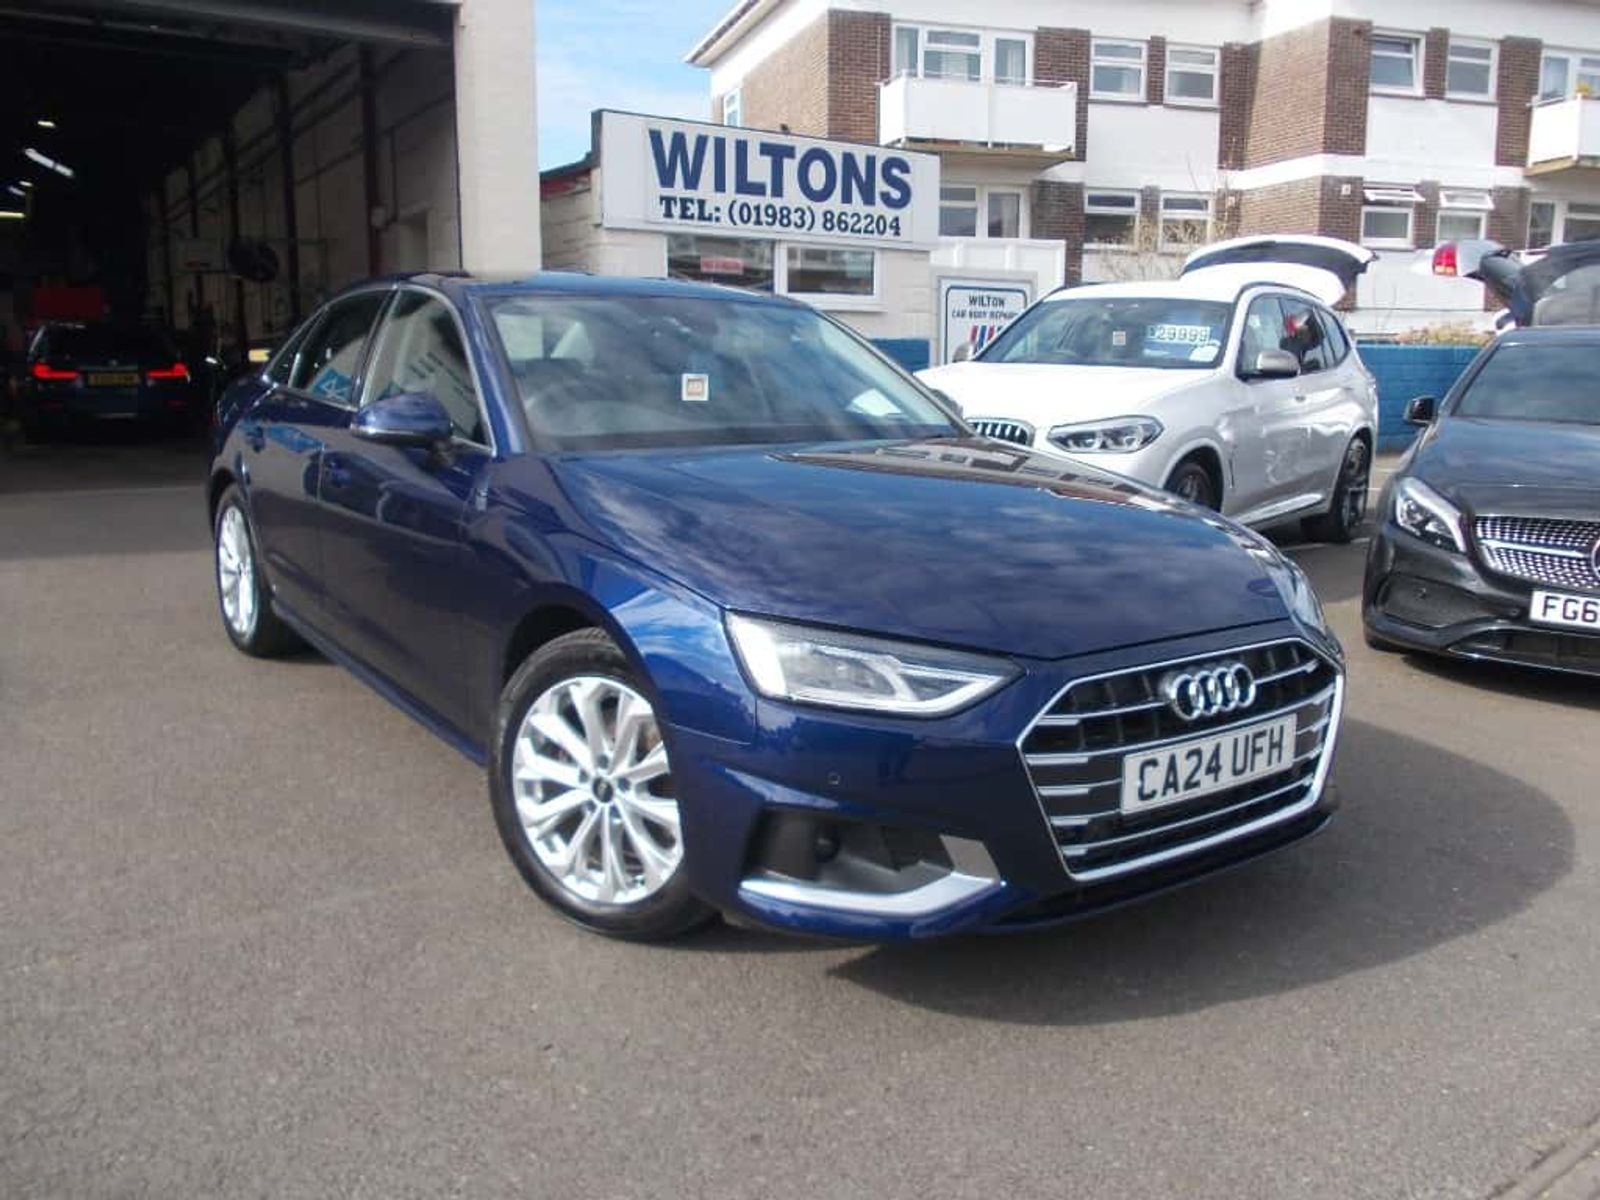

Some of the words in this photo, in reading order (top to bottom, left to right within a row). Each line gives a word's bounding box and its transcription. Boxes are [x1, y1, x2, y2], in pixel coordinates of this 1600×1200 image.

[648, 129, 912, 209] WILTONS
[659, 195, 721, 222] TEL:
[728, 199, 816, 231] (01983)
[822, 210, 901, 237] 862204
[952, 308, 967, 318] CAR
[968, 295, 1005, 307] WILTON
[1541, 595, 1599, 623] FG6
[1138, 742, 1223, 801] CA24
[1231, 724, 1285, 777] UFH
